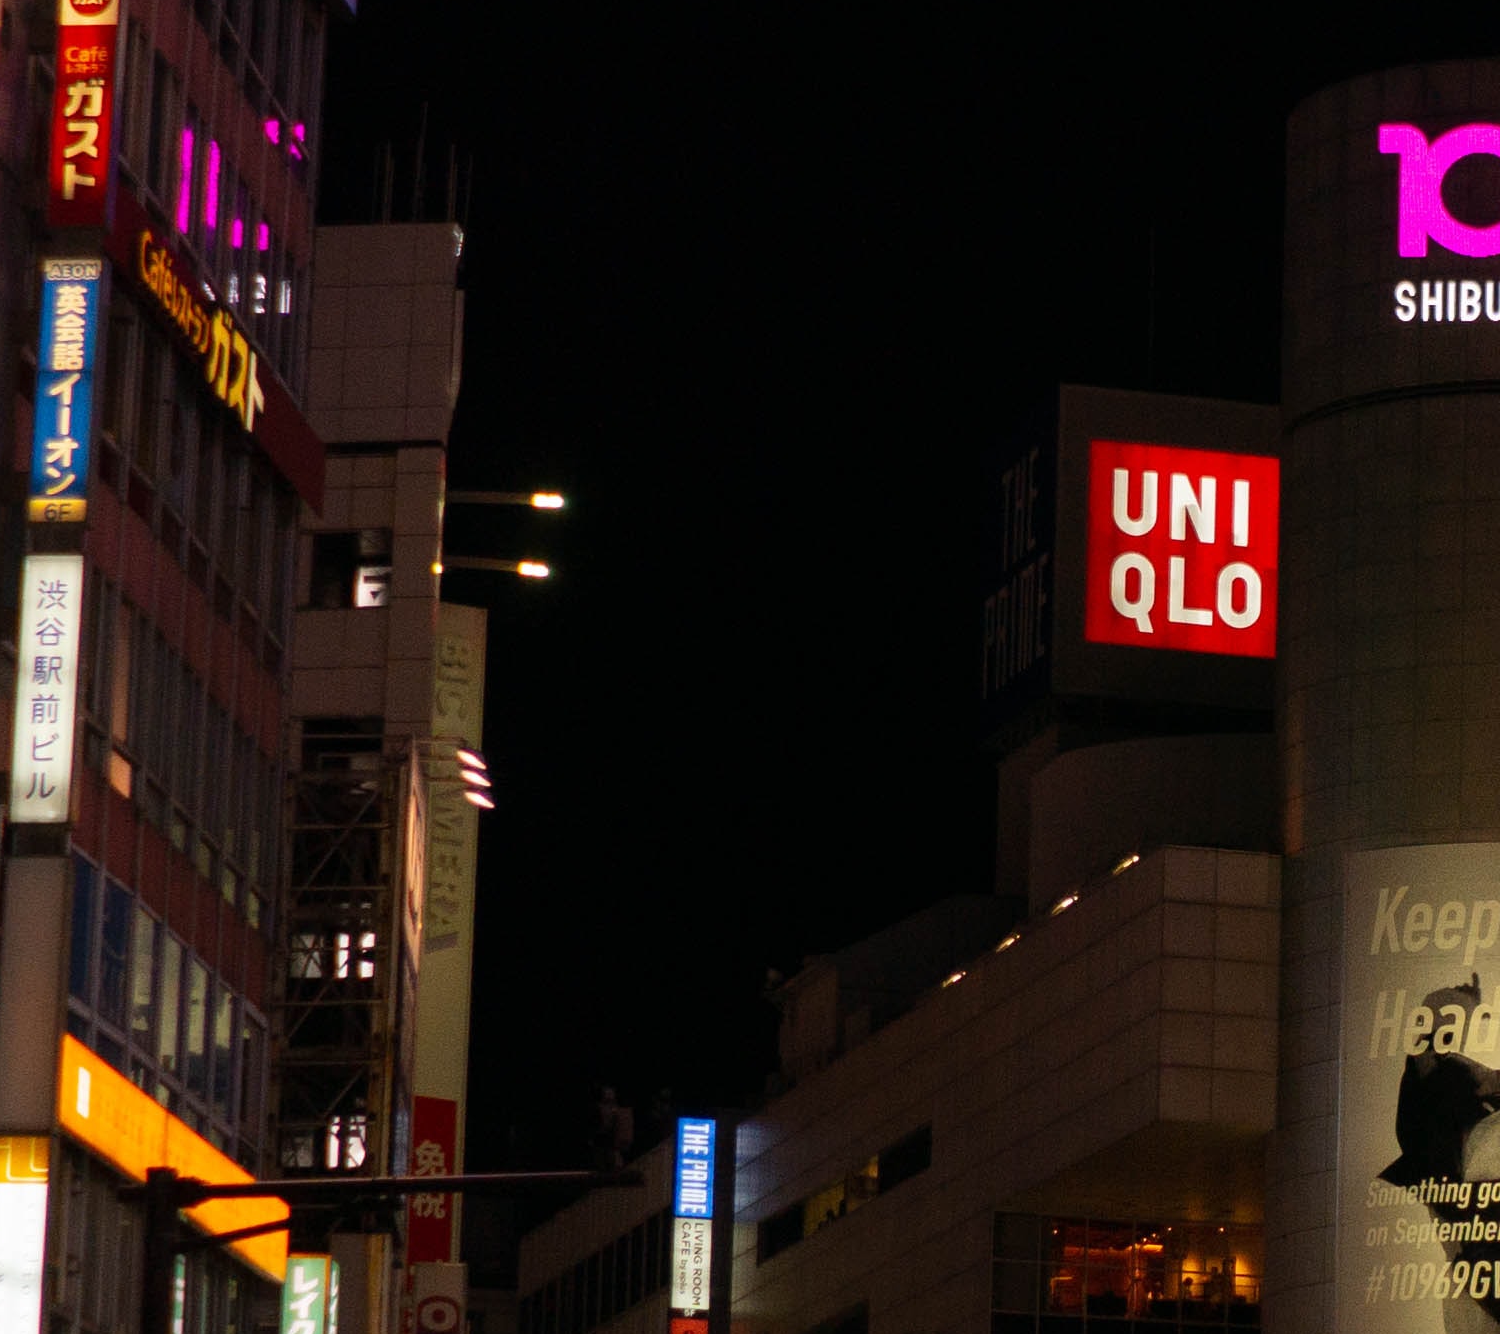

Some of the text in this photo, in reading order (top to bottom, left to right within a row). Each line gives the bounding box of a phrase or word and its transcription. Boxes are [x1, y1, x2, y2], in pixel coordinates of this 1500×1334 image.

[62, 78, 106, 201] ガスト
[47, 263, 98, 280] AEON
[44, 284, 88, 496] 英会話イーオン
[207, 308, 265, 434] ガスト
[43, 504, 73, 521] 6F
[1110, 467, 1251, 549] UNI
[1109, 550, 1264, 634] QLO
[26, 578, 69, 802] 渋谷駅前ビル
[1369, 886, 1500, 967] Keep
[680, 1123, 710, 1215] THE PRIME
[1366, 1176, 1473, 1210] Something
[681, 1221, 692, 1255] CAFE
[692, 1222, 705, 1307] LIVING ROOM
[1366, 1224, 1389, 1247] on
